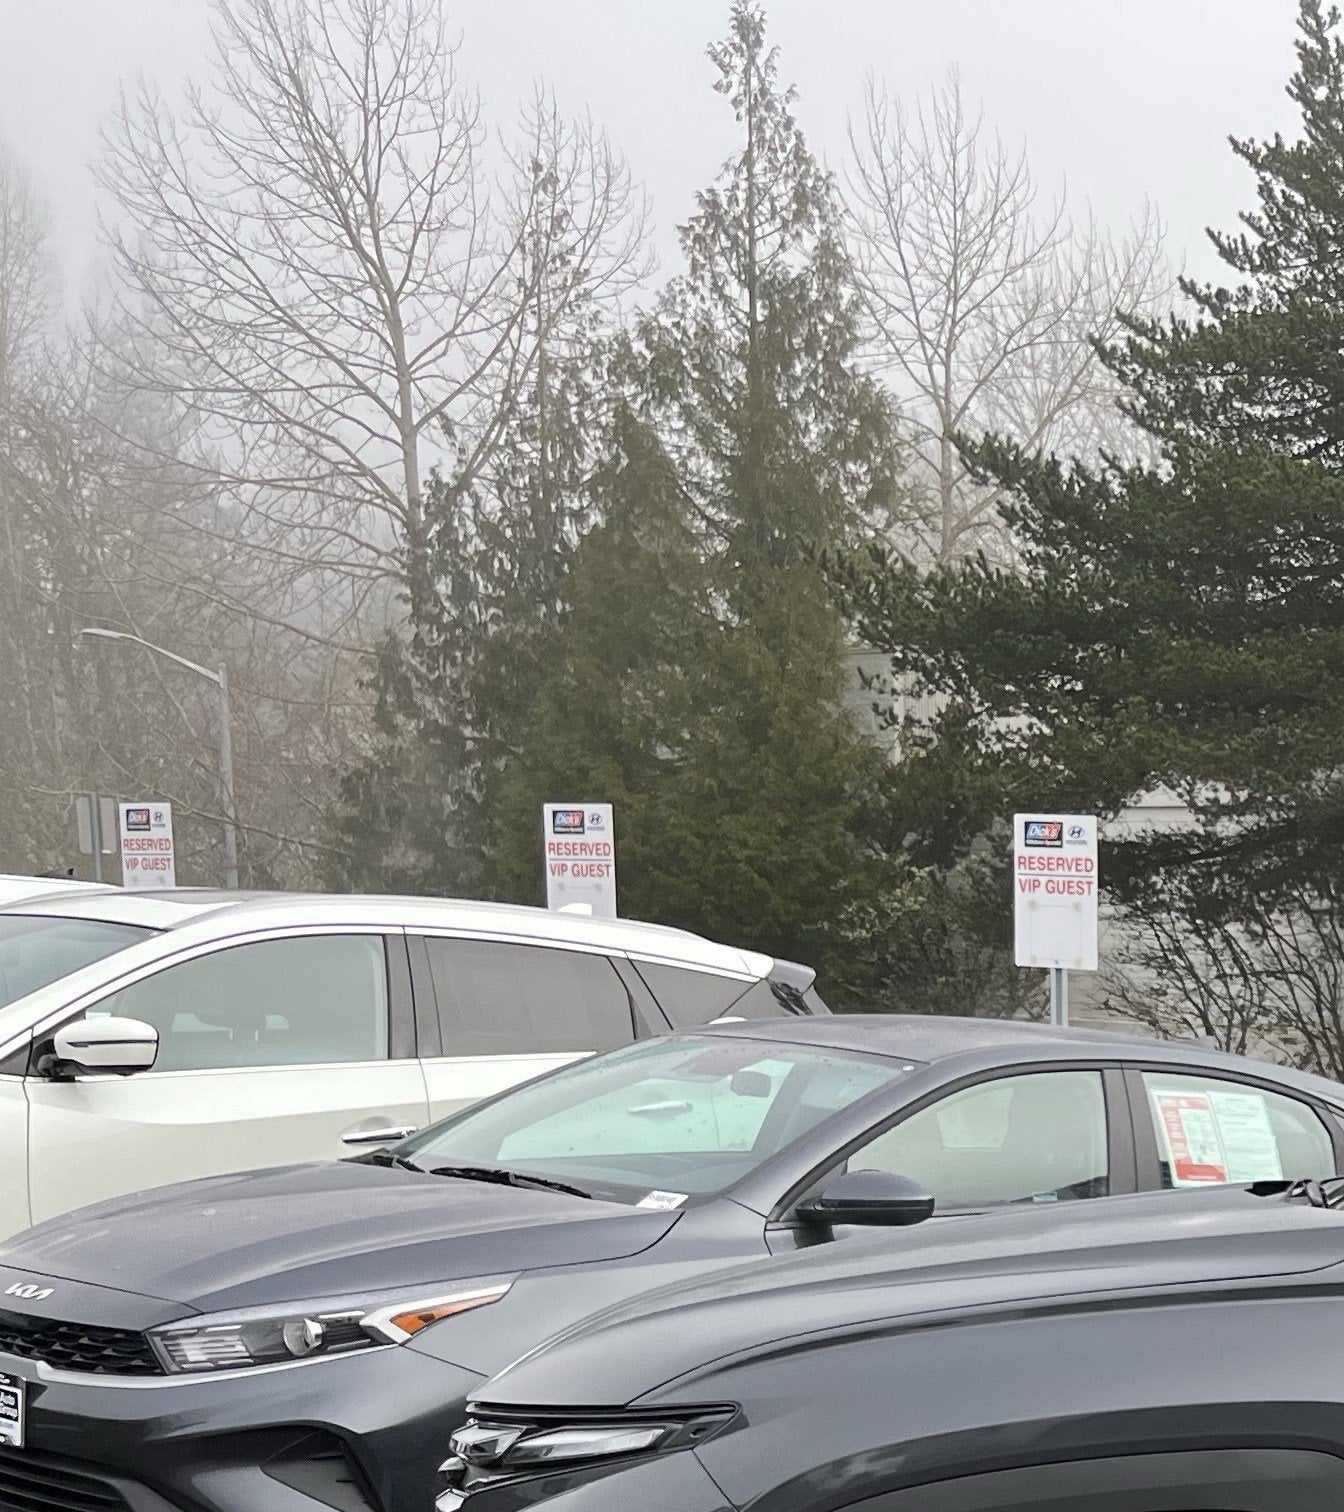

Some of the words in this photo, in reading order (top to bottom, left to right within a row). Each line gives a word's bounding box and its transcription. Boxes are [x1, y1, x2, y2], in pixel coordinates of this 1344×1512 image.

[123, 839, 171, 851] RESERVED
[548, 842, 611, 857] RESERVED
[125, 858, 139, 870] VIP
[141, 858, 171, 871] GUEST
[549, 863, 568, 877] VIP
[571, 863, 612, 877] GUEST
[1017, 856, 1094, 873] RESERVED
[1018, 879, 1040, 893] VIP
[1045, 880, 1094, 896] GUEST
